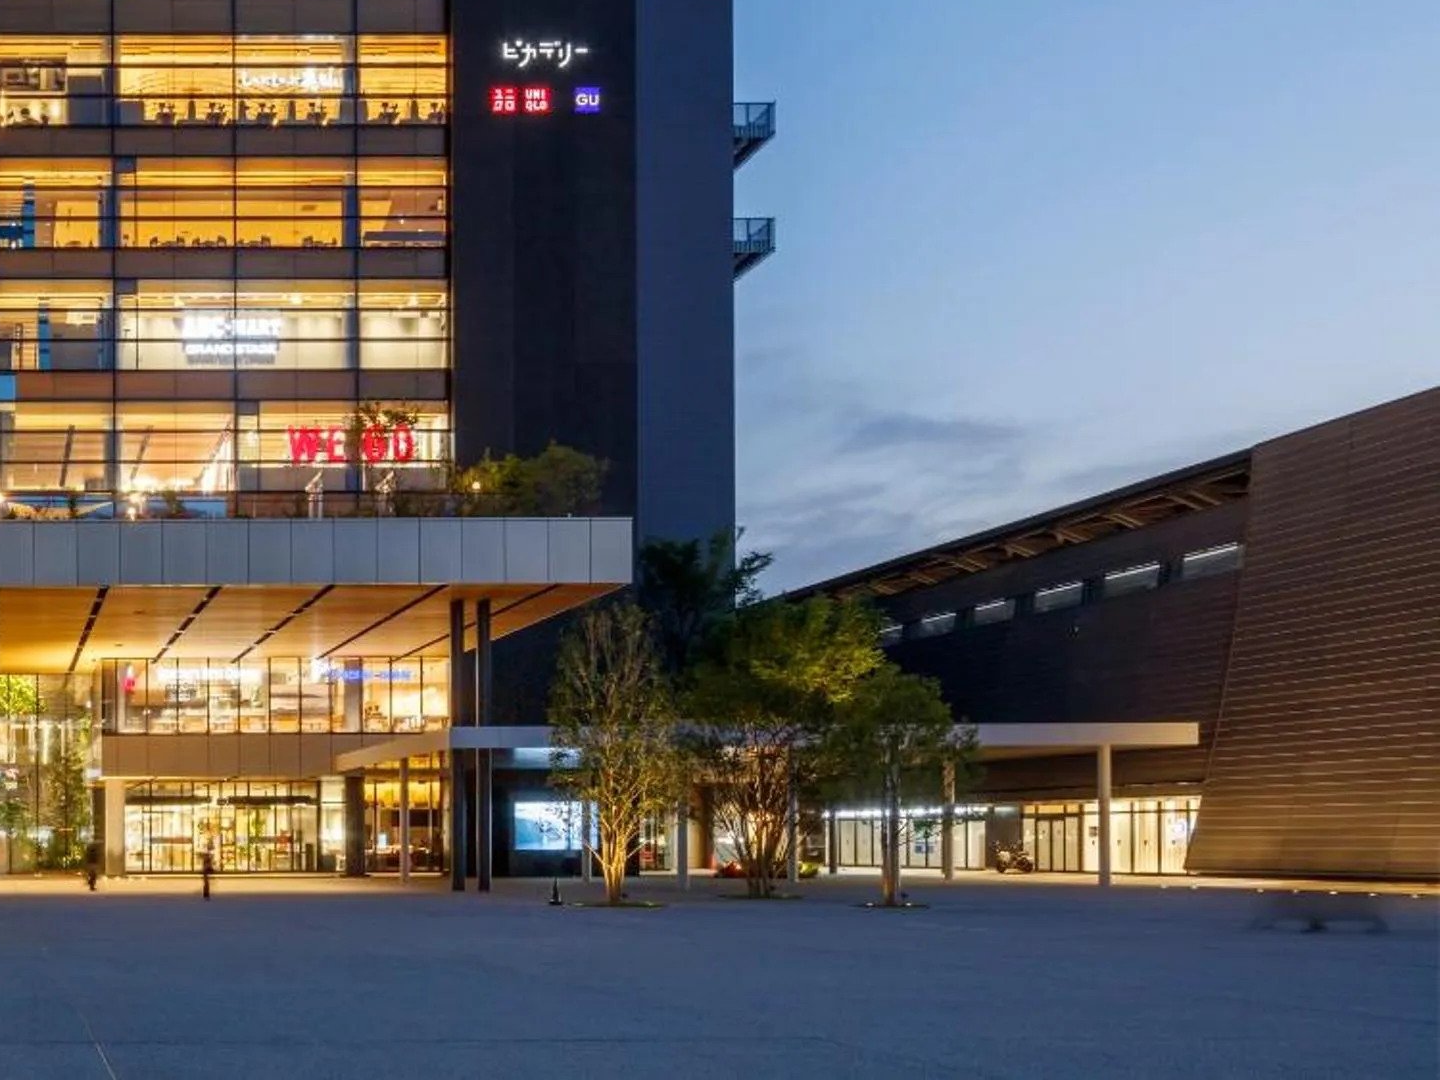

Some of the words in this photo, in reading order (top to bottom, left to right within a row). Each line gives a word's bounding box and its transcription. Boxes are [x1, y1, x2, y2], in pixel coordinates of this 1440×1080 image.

[502, 38, 589, 69] ピカデリー
[575, 93, 600, 107] GU
